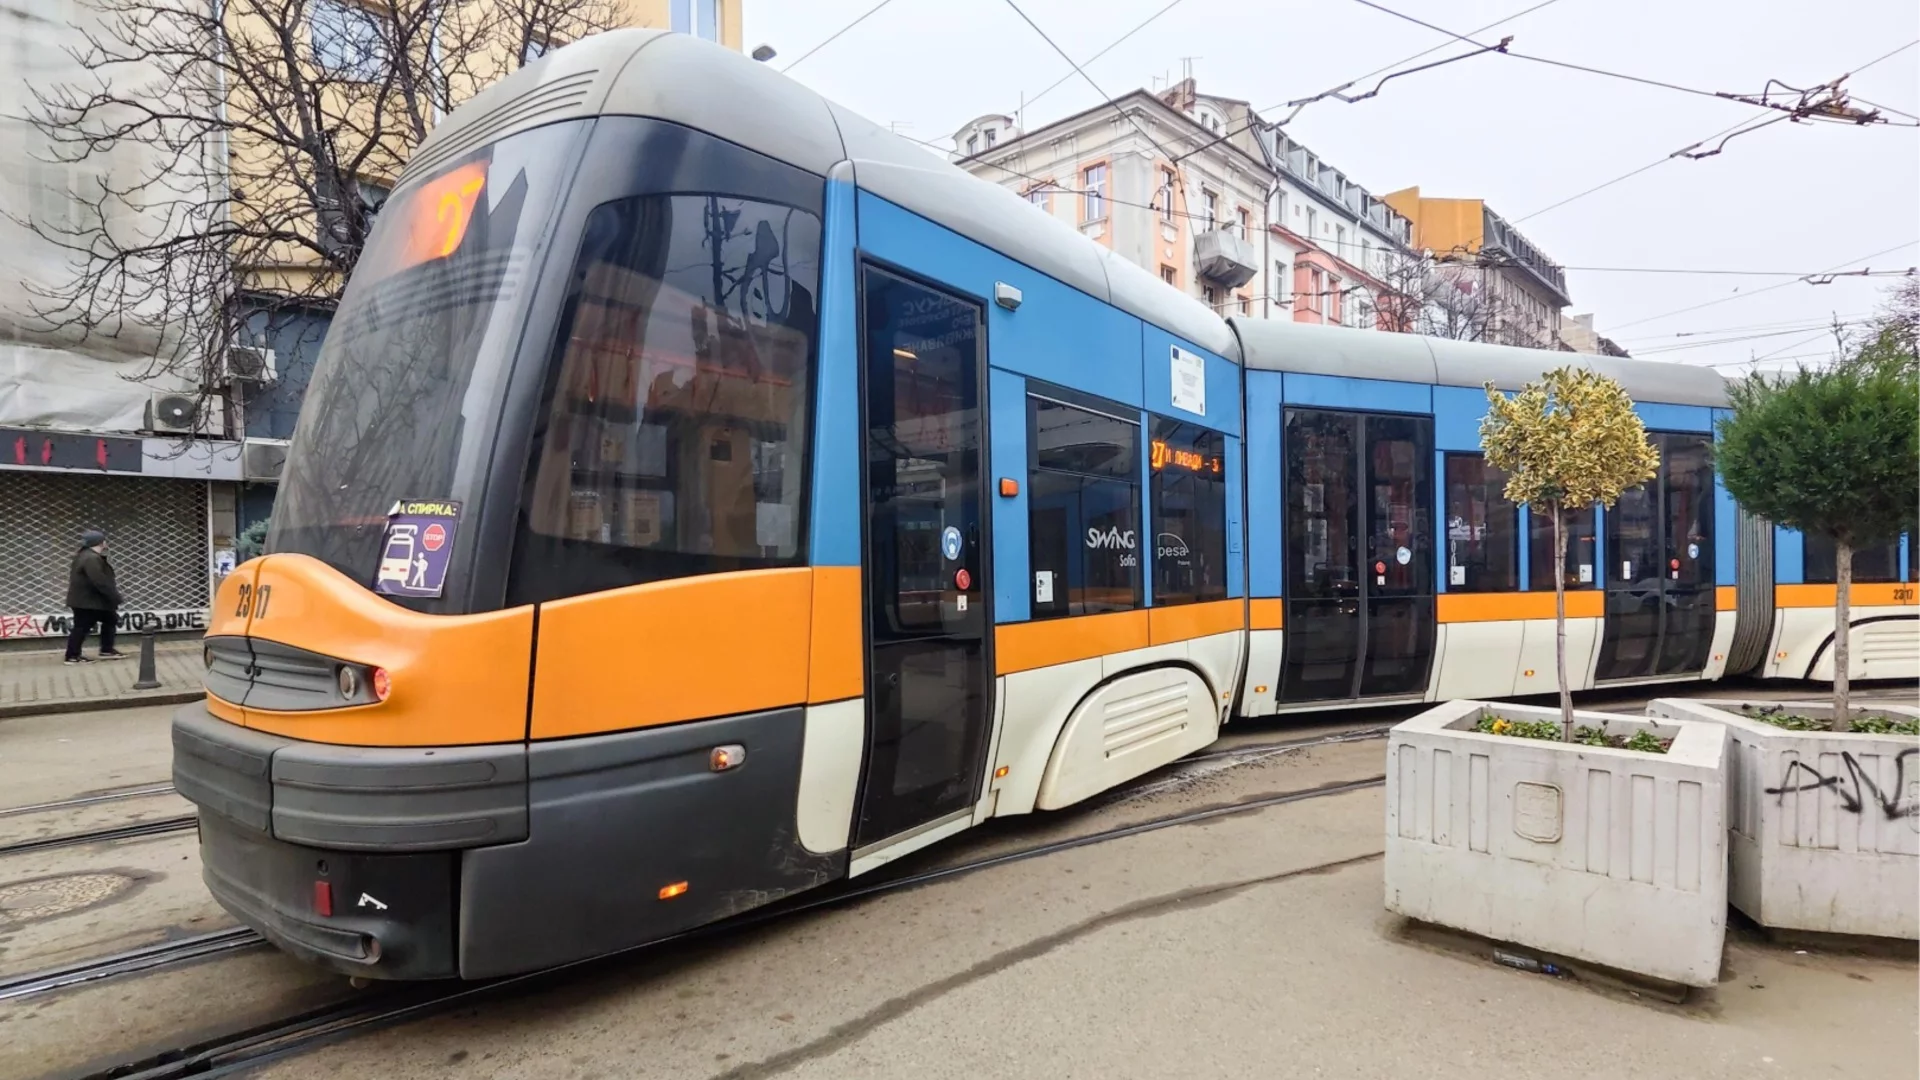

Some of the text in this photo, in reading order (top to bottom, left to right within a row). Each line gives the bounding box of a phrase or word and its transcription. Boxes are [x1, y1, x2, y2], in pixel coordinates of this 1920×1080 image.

[408, 503, 457, 516] СПИРКА:
[1158, 546, 1187, 560] pesa
[1120, 554, 1136, 567] Sofia
